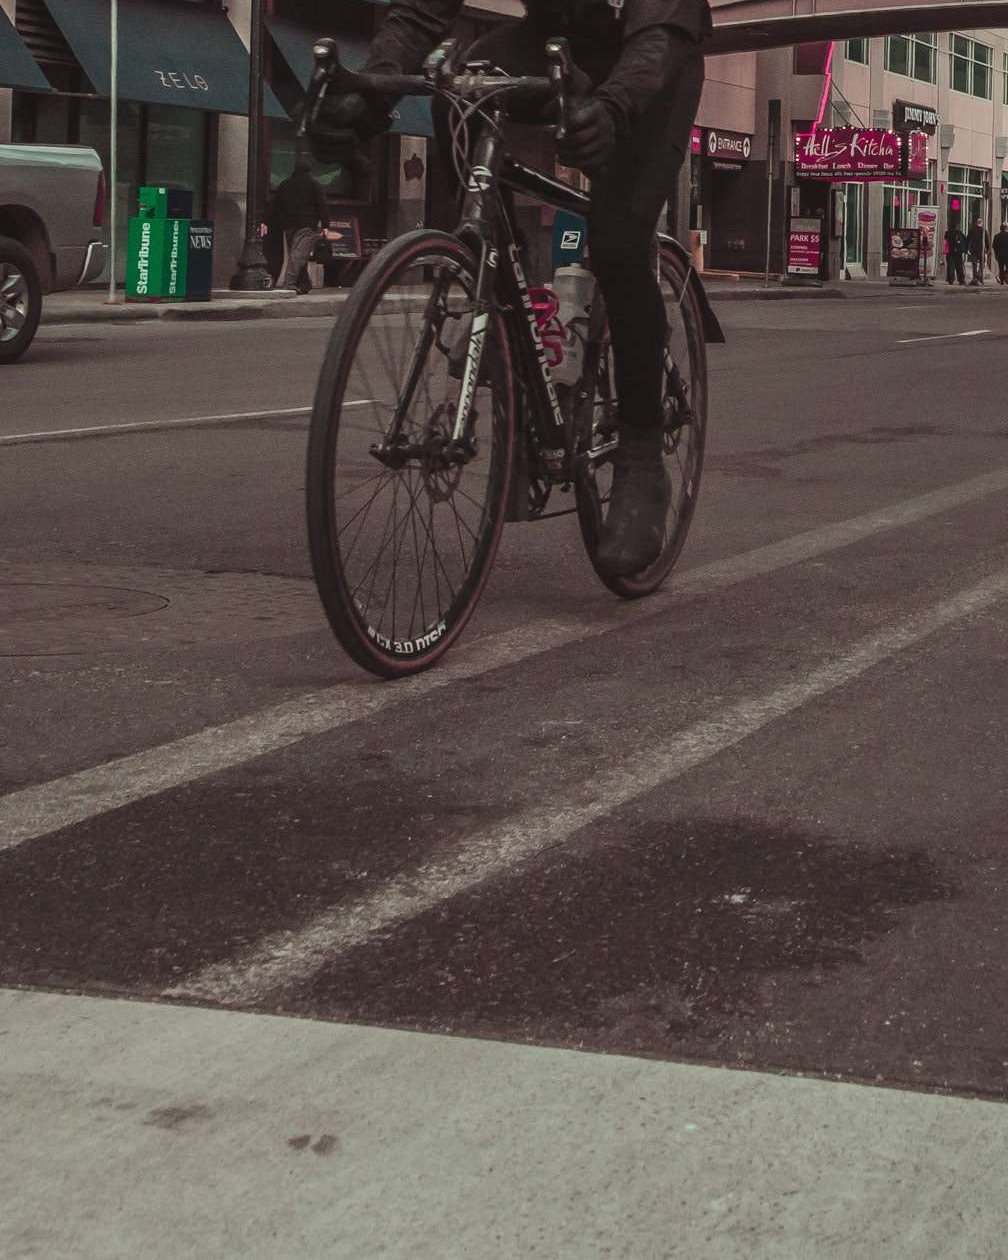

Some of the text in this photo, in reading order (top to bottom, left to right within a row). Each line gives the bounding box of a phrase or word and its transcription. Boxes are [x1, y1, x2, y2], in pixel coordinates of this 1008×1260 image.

[154, 70, 209, 91] ZELO
[904, 106, 923, 122] JIMMY
[717, 137, 743, 152] ENTRANCE
[803, 133, 848, 163] Hell's
[189, 235, 213, 249] NEWS
[790, 234, 809, 242] PARK
[136, 222, 151, 294] StarTribune
